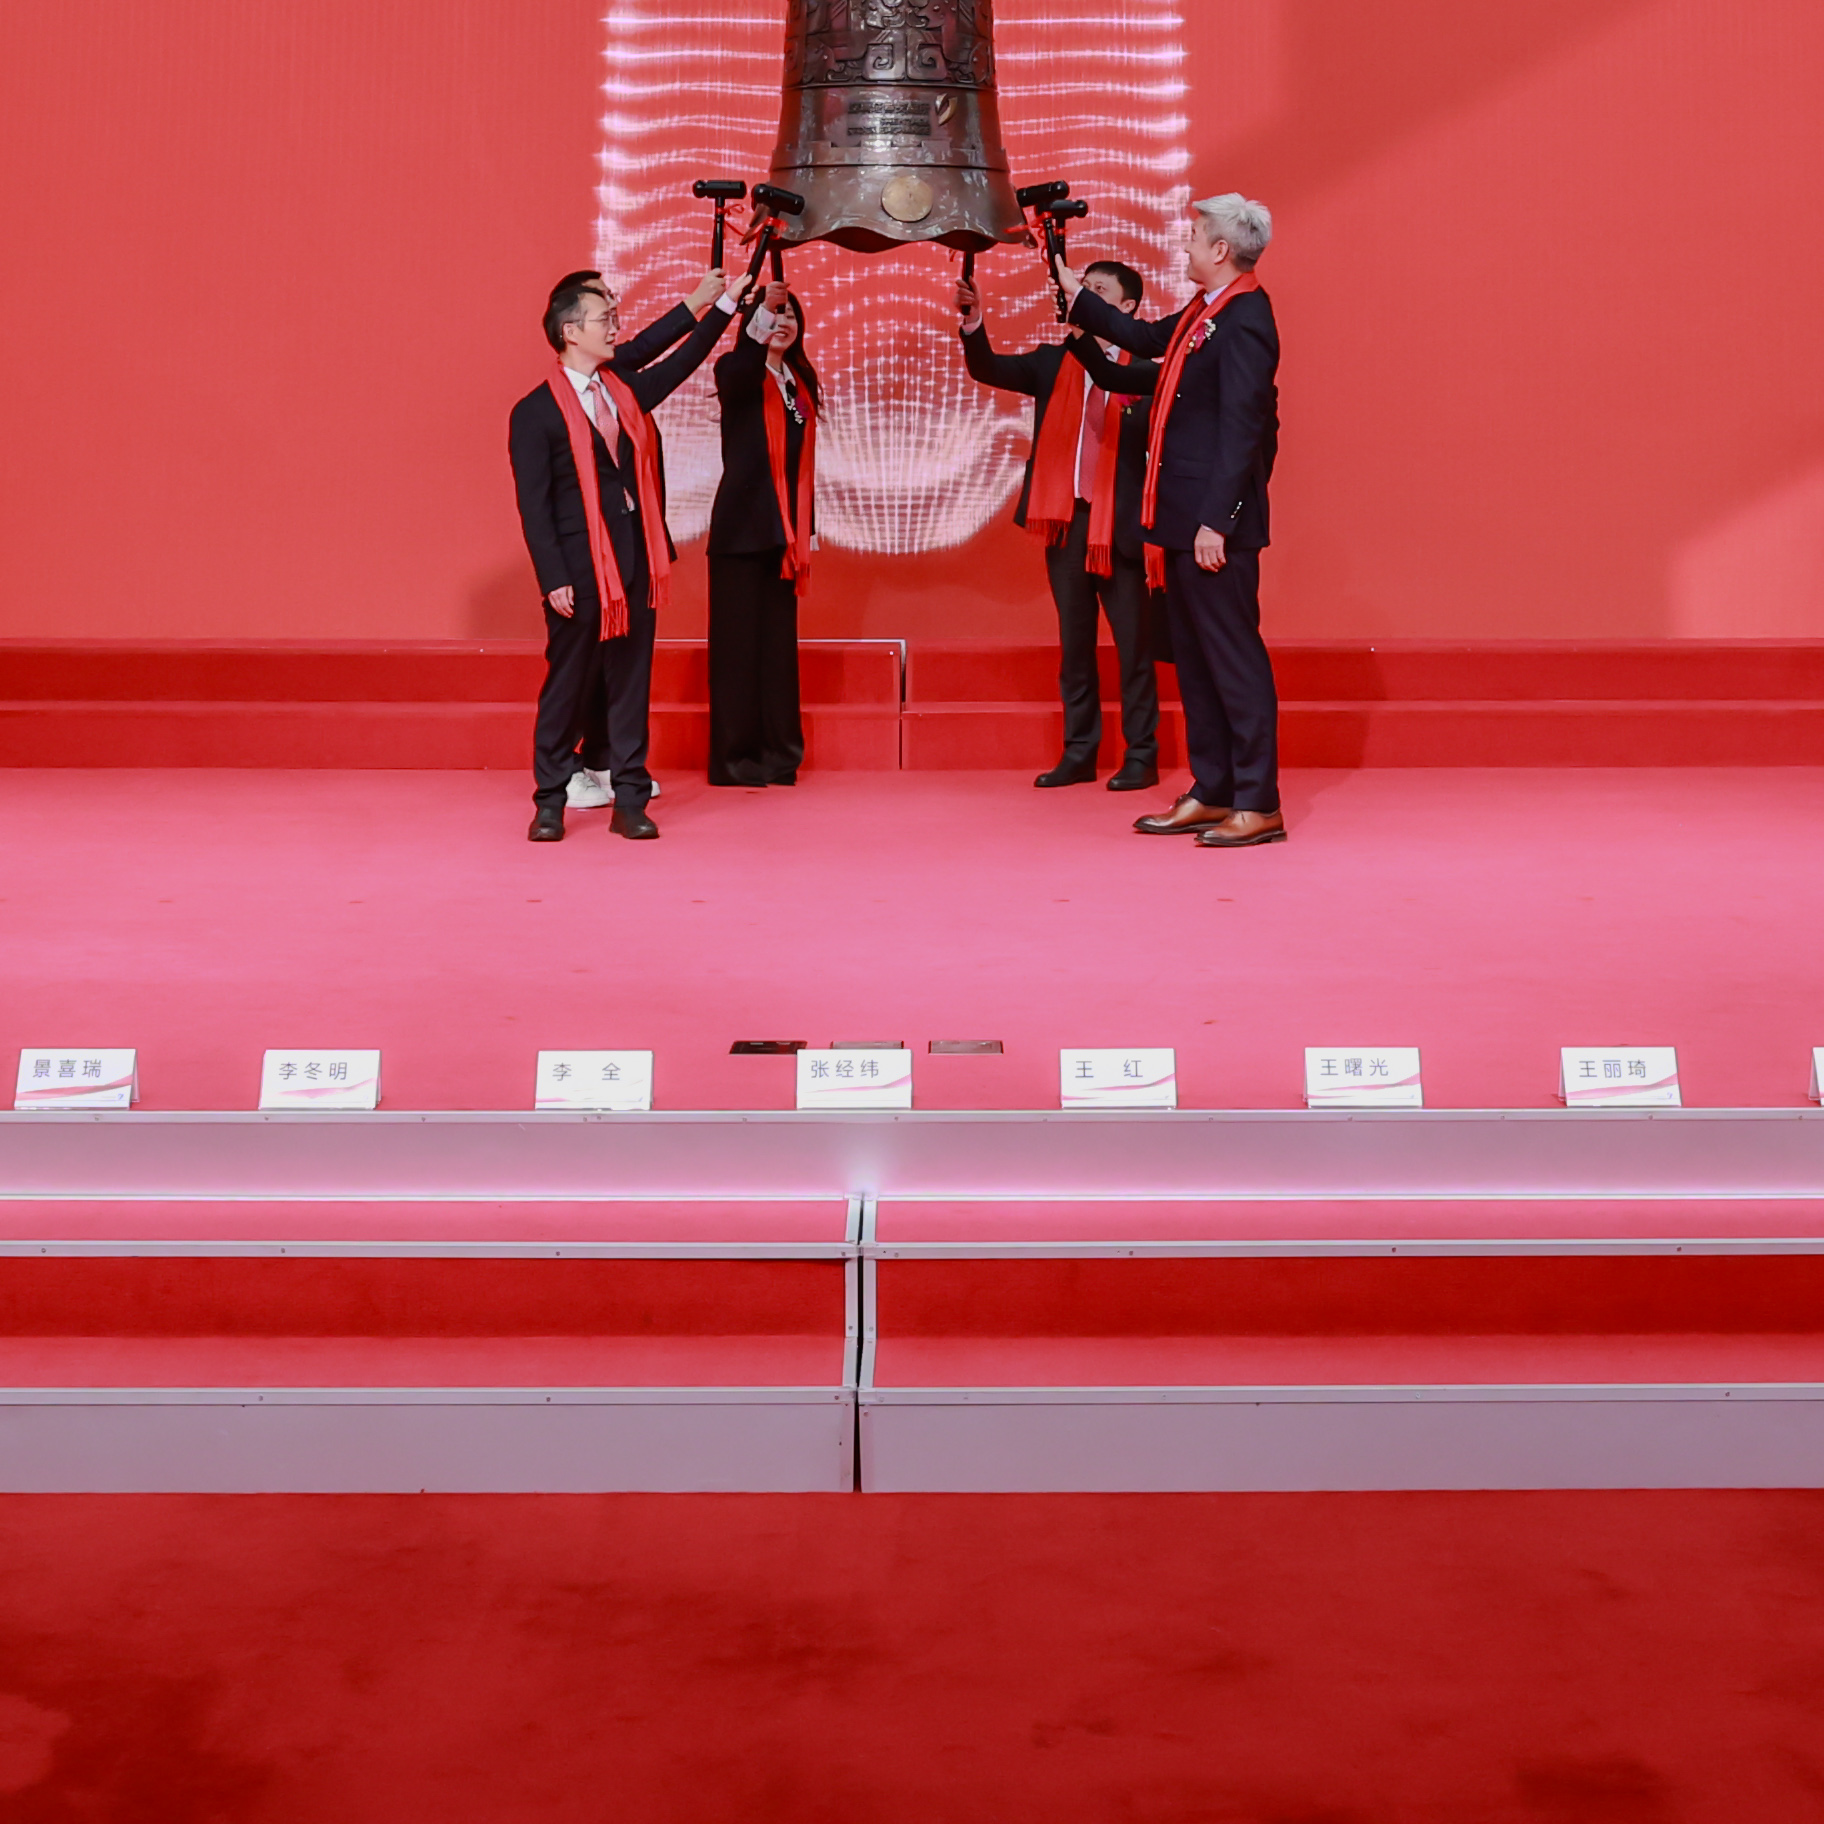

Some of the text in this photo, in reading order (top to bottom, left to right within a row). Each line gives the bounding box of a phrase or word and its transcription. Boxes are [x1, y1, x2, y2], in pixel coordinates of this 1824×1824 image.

[32, 1058, 103, 1079] 景喜瑞
[278, 1061, 349, 1081] 李冬明
[810, 1058, 880, 1079] 张经纬
[1319, 1057, 1390, 1077] 王曙光
[1579, 1058, 1647, 1079] 王丽琦
